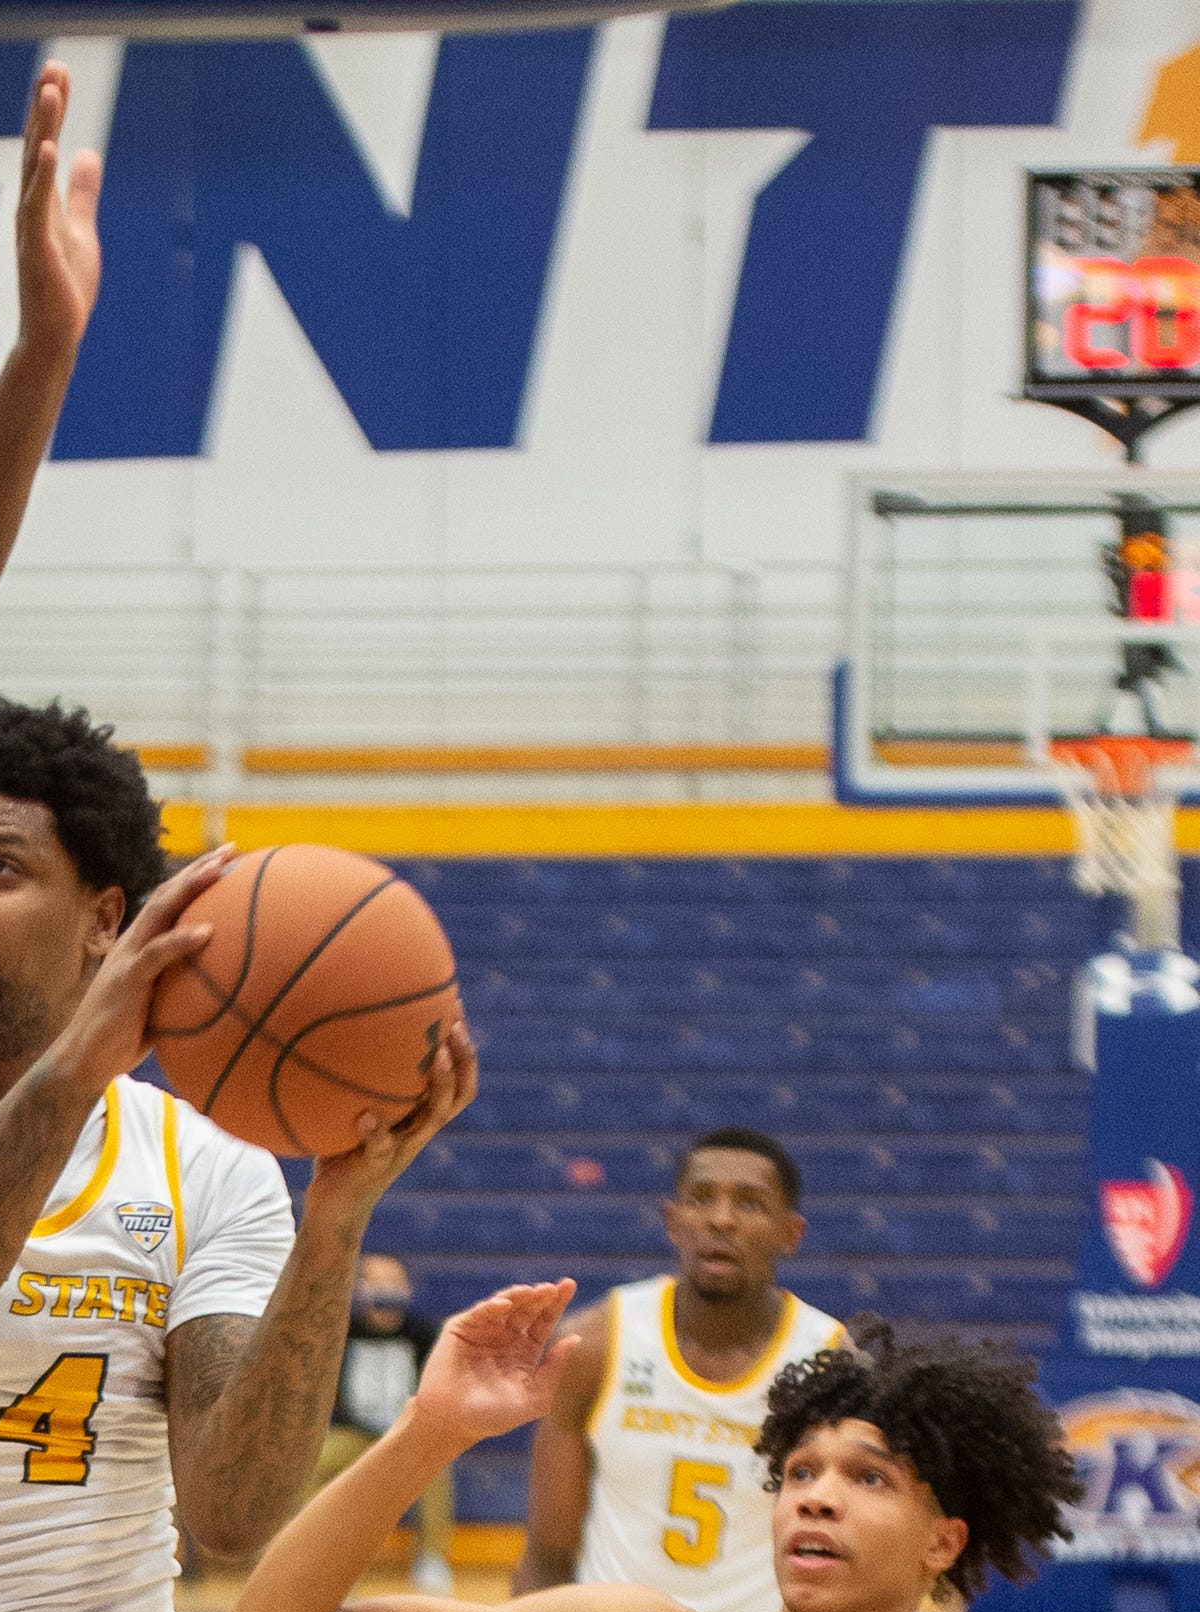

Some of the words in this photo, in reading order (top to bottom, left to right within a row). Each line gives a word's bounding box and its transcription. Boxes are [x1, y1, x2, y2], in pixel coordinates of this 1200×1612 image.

[120, 1215, 172, 1232] MAC
[10, 1271, 173, 1329] STATE
[663, 1458, 731, 1567] 5
